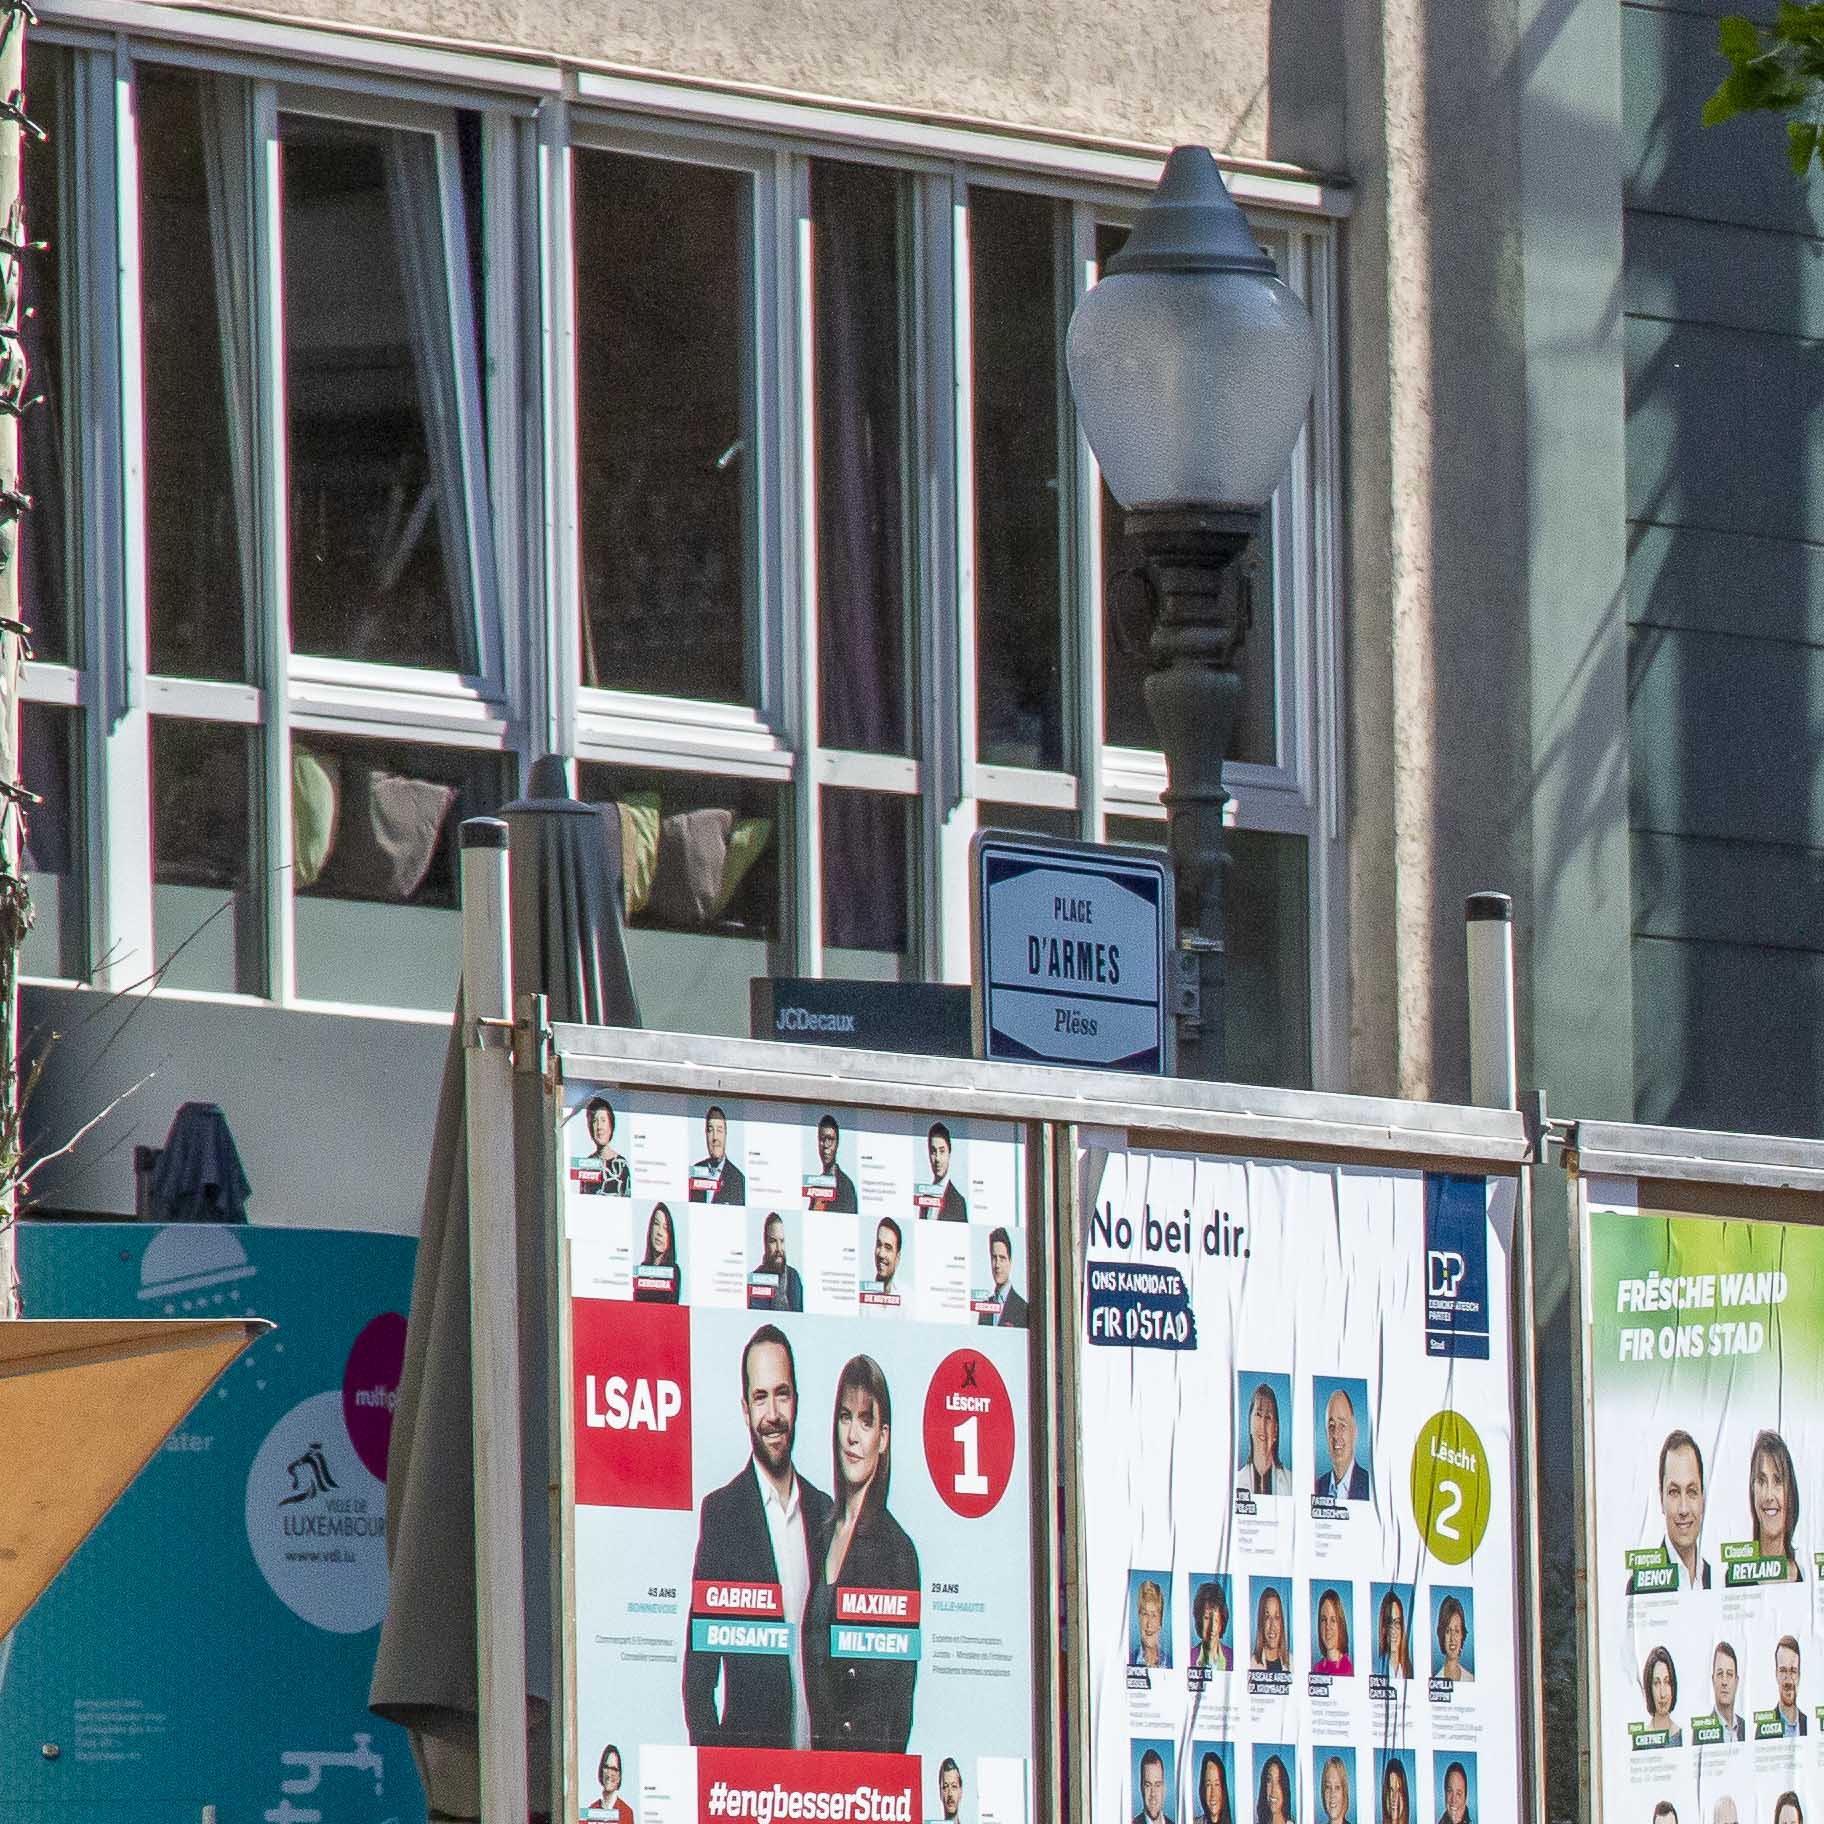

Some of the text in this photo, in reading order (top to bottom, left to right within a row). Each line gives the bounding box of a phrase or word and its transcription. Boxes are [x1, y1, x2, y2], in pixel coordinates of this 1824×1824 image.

[1054, 896, 1092, 924] PLACE
[1028, 935, 1120, 985] D'ARMES
[776, 1007, 856, 1032] JCDecaux
[1054, 1008, 1098, 1036] Plëss
[1090, 1201, 1251, 1259] No bei dir.
[1092, 1270, 1181, 1296] ONS KANDIDATE
[1428, 1250, 1465, 1297] DP
[1617, 1270, 1788, 1314] FRËSCHE WAND
[1092, 1304, 1190, 1344] FIR D'STAD
[1618, 1320, 1765, 1362] FIR ONS STAD
[585, 1374, 682, 1432] LSAP
[945, 1392, 992, 1414] LËSCHT
[953, 1415, 988, 1495] 1
[1430, 1435, 1478, 1472] Lëscht
[1435, 1480, 1463, 1541] 2
[283, 1514, 385, 1538] LUXEMBOUR
[1637, 1569, 1673, 1587] BENOY
[1732, 1561, 1782, 1579] REYLAND
[705, 1586, 777, 1610] GABRIEL
[942, 1584, 959, 1594] ANS
[841, 1592, 908, 1616] MAXIME
[707, 1625, 790, 1649] BOISANTE
[837, 1631, 909, 1654] MILTGEN
